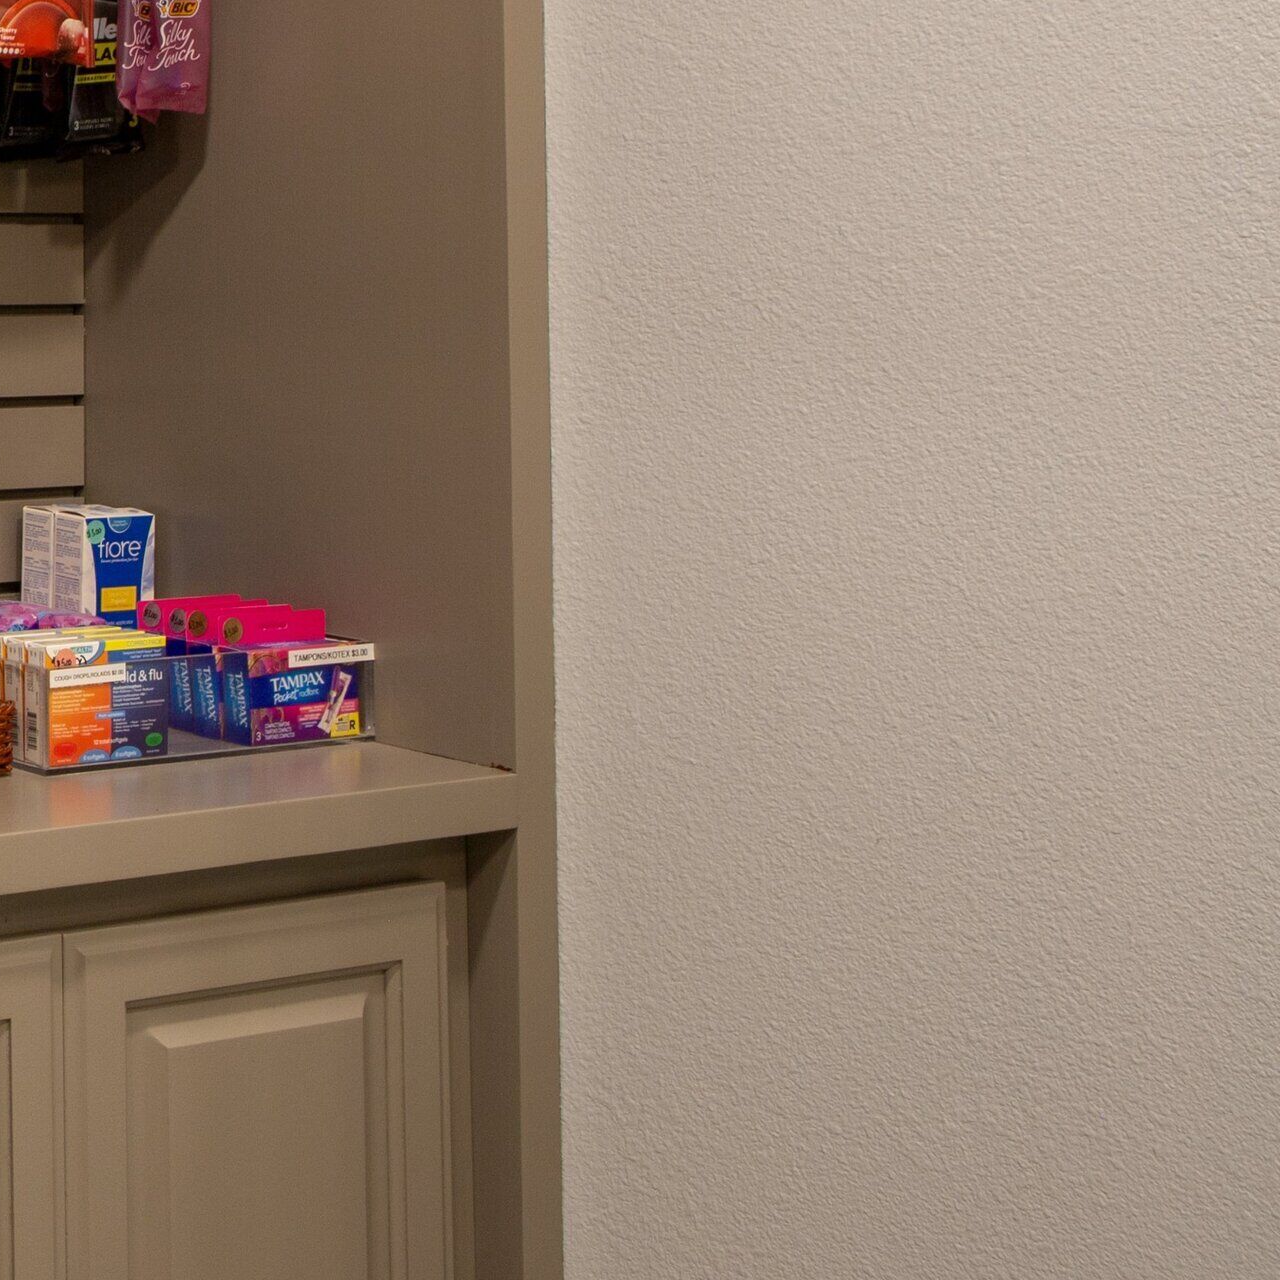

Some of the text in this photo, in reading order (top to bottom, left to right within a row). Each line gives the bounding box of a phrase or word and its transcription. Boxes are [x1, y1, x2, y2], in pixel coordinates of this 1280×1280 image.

[159, 19, 193, 50] Silky
[148, 39, 200, 72] Touch
[98, 538, 141, 558] fiore
[294, 649, 368, 662] TAMPONS/KOTEX $3.00
[138, 668, 163, 682] & flu
[270, 671, 326, 691] TAMPAX
[205, 665, 216, 722] TAMPAX
[234, 671, 248, 728] TAMPAX
[273, 690, 299, 705] Pocket
[349, 720, 356, 730] R
[256, 731, 262, 741] 3
